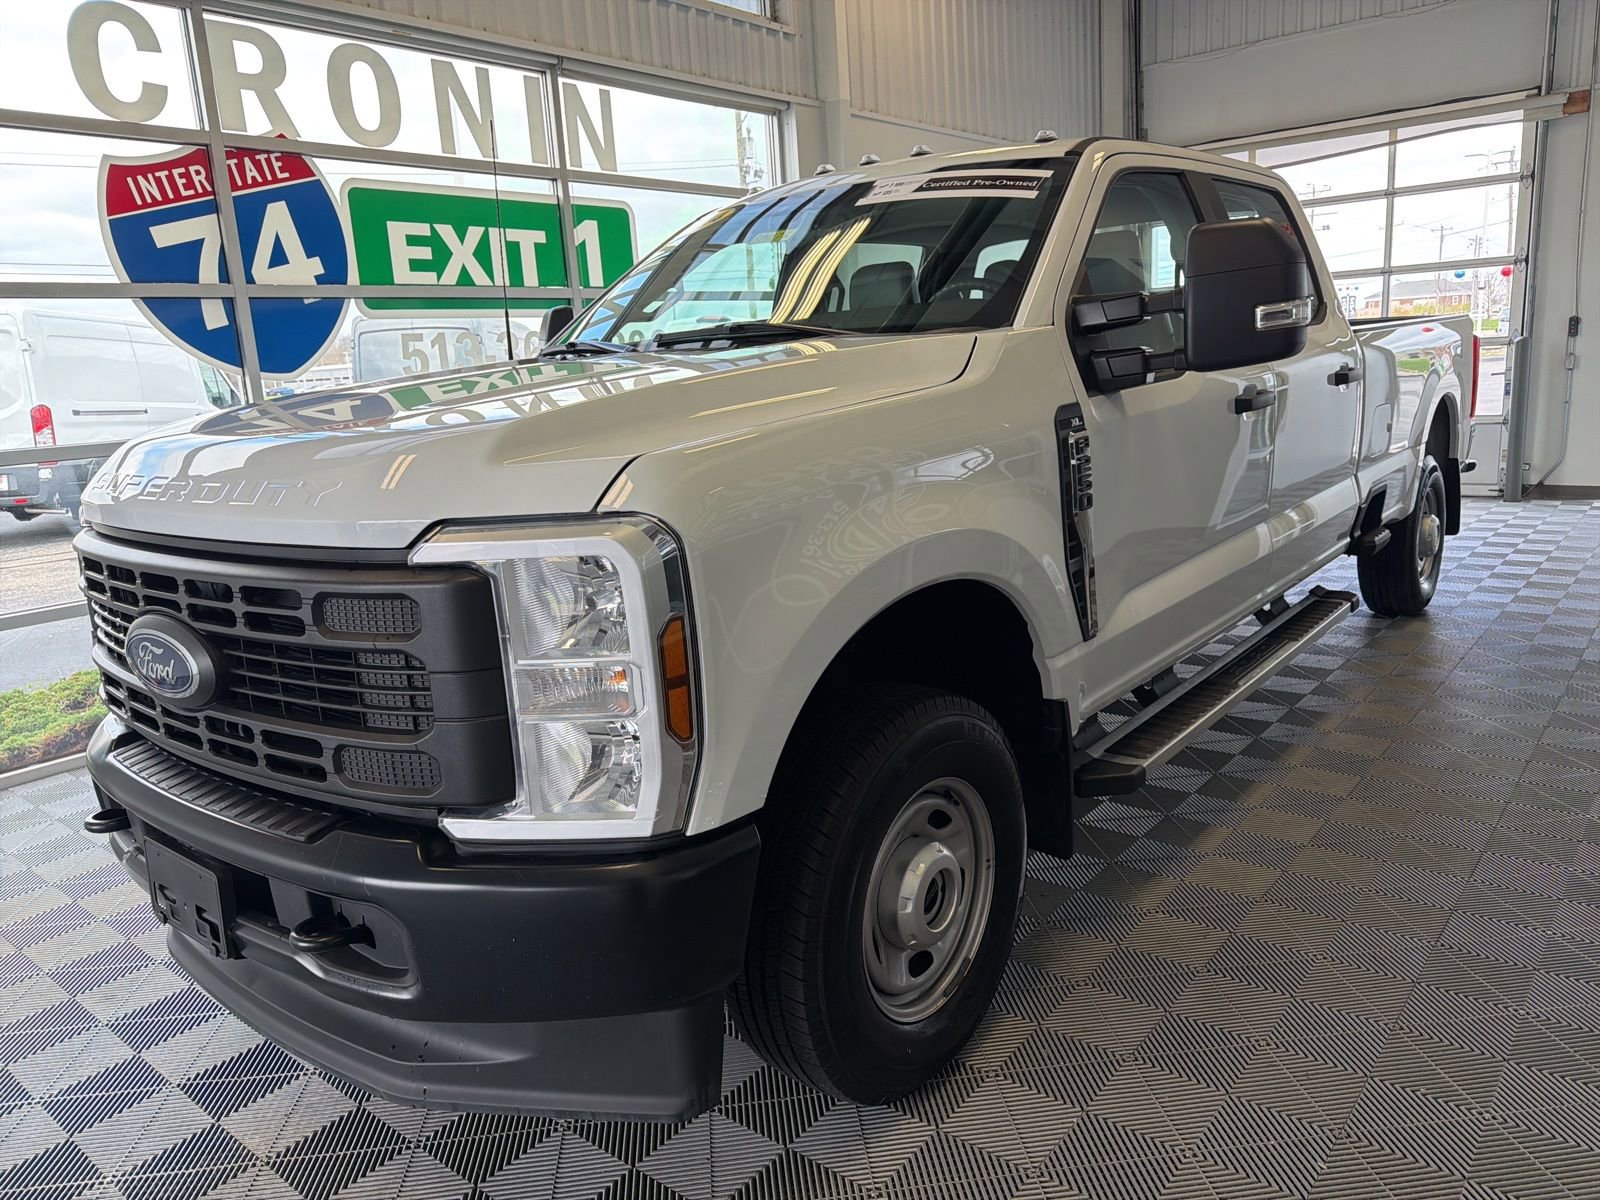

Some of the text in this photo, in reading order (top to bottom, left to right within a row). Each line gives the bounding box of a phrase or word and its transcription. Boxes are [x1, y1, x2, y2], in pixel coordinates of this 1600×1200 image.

[66, 0, 618, 173] CRONIN
[126, 151, 291, 206] INTERTATE
[922, 178, 971, 189] Certified
[972, 178, 1038, 188] Pre-Owned
[149, 200, 325, 332] 74
[385, 219, 548, 287] EXIT
[1070, 417, 1083, 428] XL
[91, 472, 343, 506] SUPER DUTY
[137, 641, 177, 685] Ford
